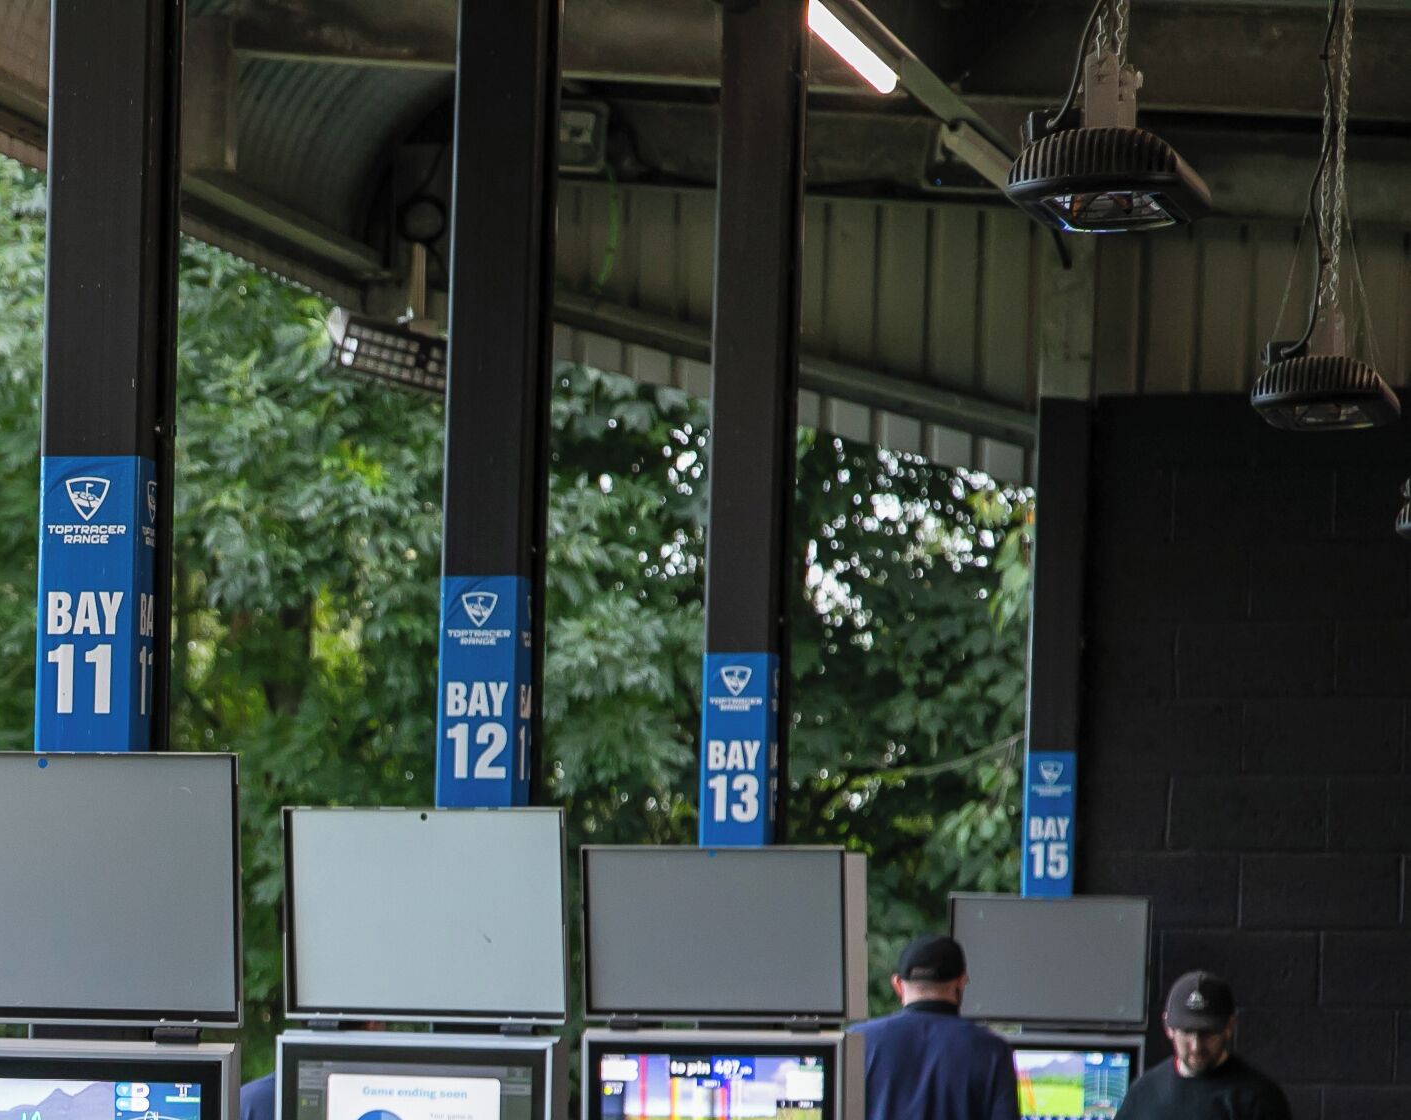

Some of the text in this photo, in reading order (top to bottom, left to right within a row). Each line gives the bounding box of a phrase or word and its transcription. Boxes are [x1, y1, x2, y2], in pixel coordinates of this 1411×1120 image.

[47, 524, 127, 535] TOPTRACER
[63, 534, 110, 544] RANGE
[46, 591, 154, 638] BAY BA
[447, 629, 512, 638] TOPTRACER
[460, 637, 497, 646] RANGE
[47, 643, 112, 714] 11
[446, 681, 509, 718] BAY
[446, 722, 508, 779] 12
[707, 739, 761, 771] BAY
[707, 774, 759, 823] 13
[1030, 815, 1070, 841] BAY
[1029, 842, 1069, 879] 15
[362, 1086, 468, 1100] Game ending soon
